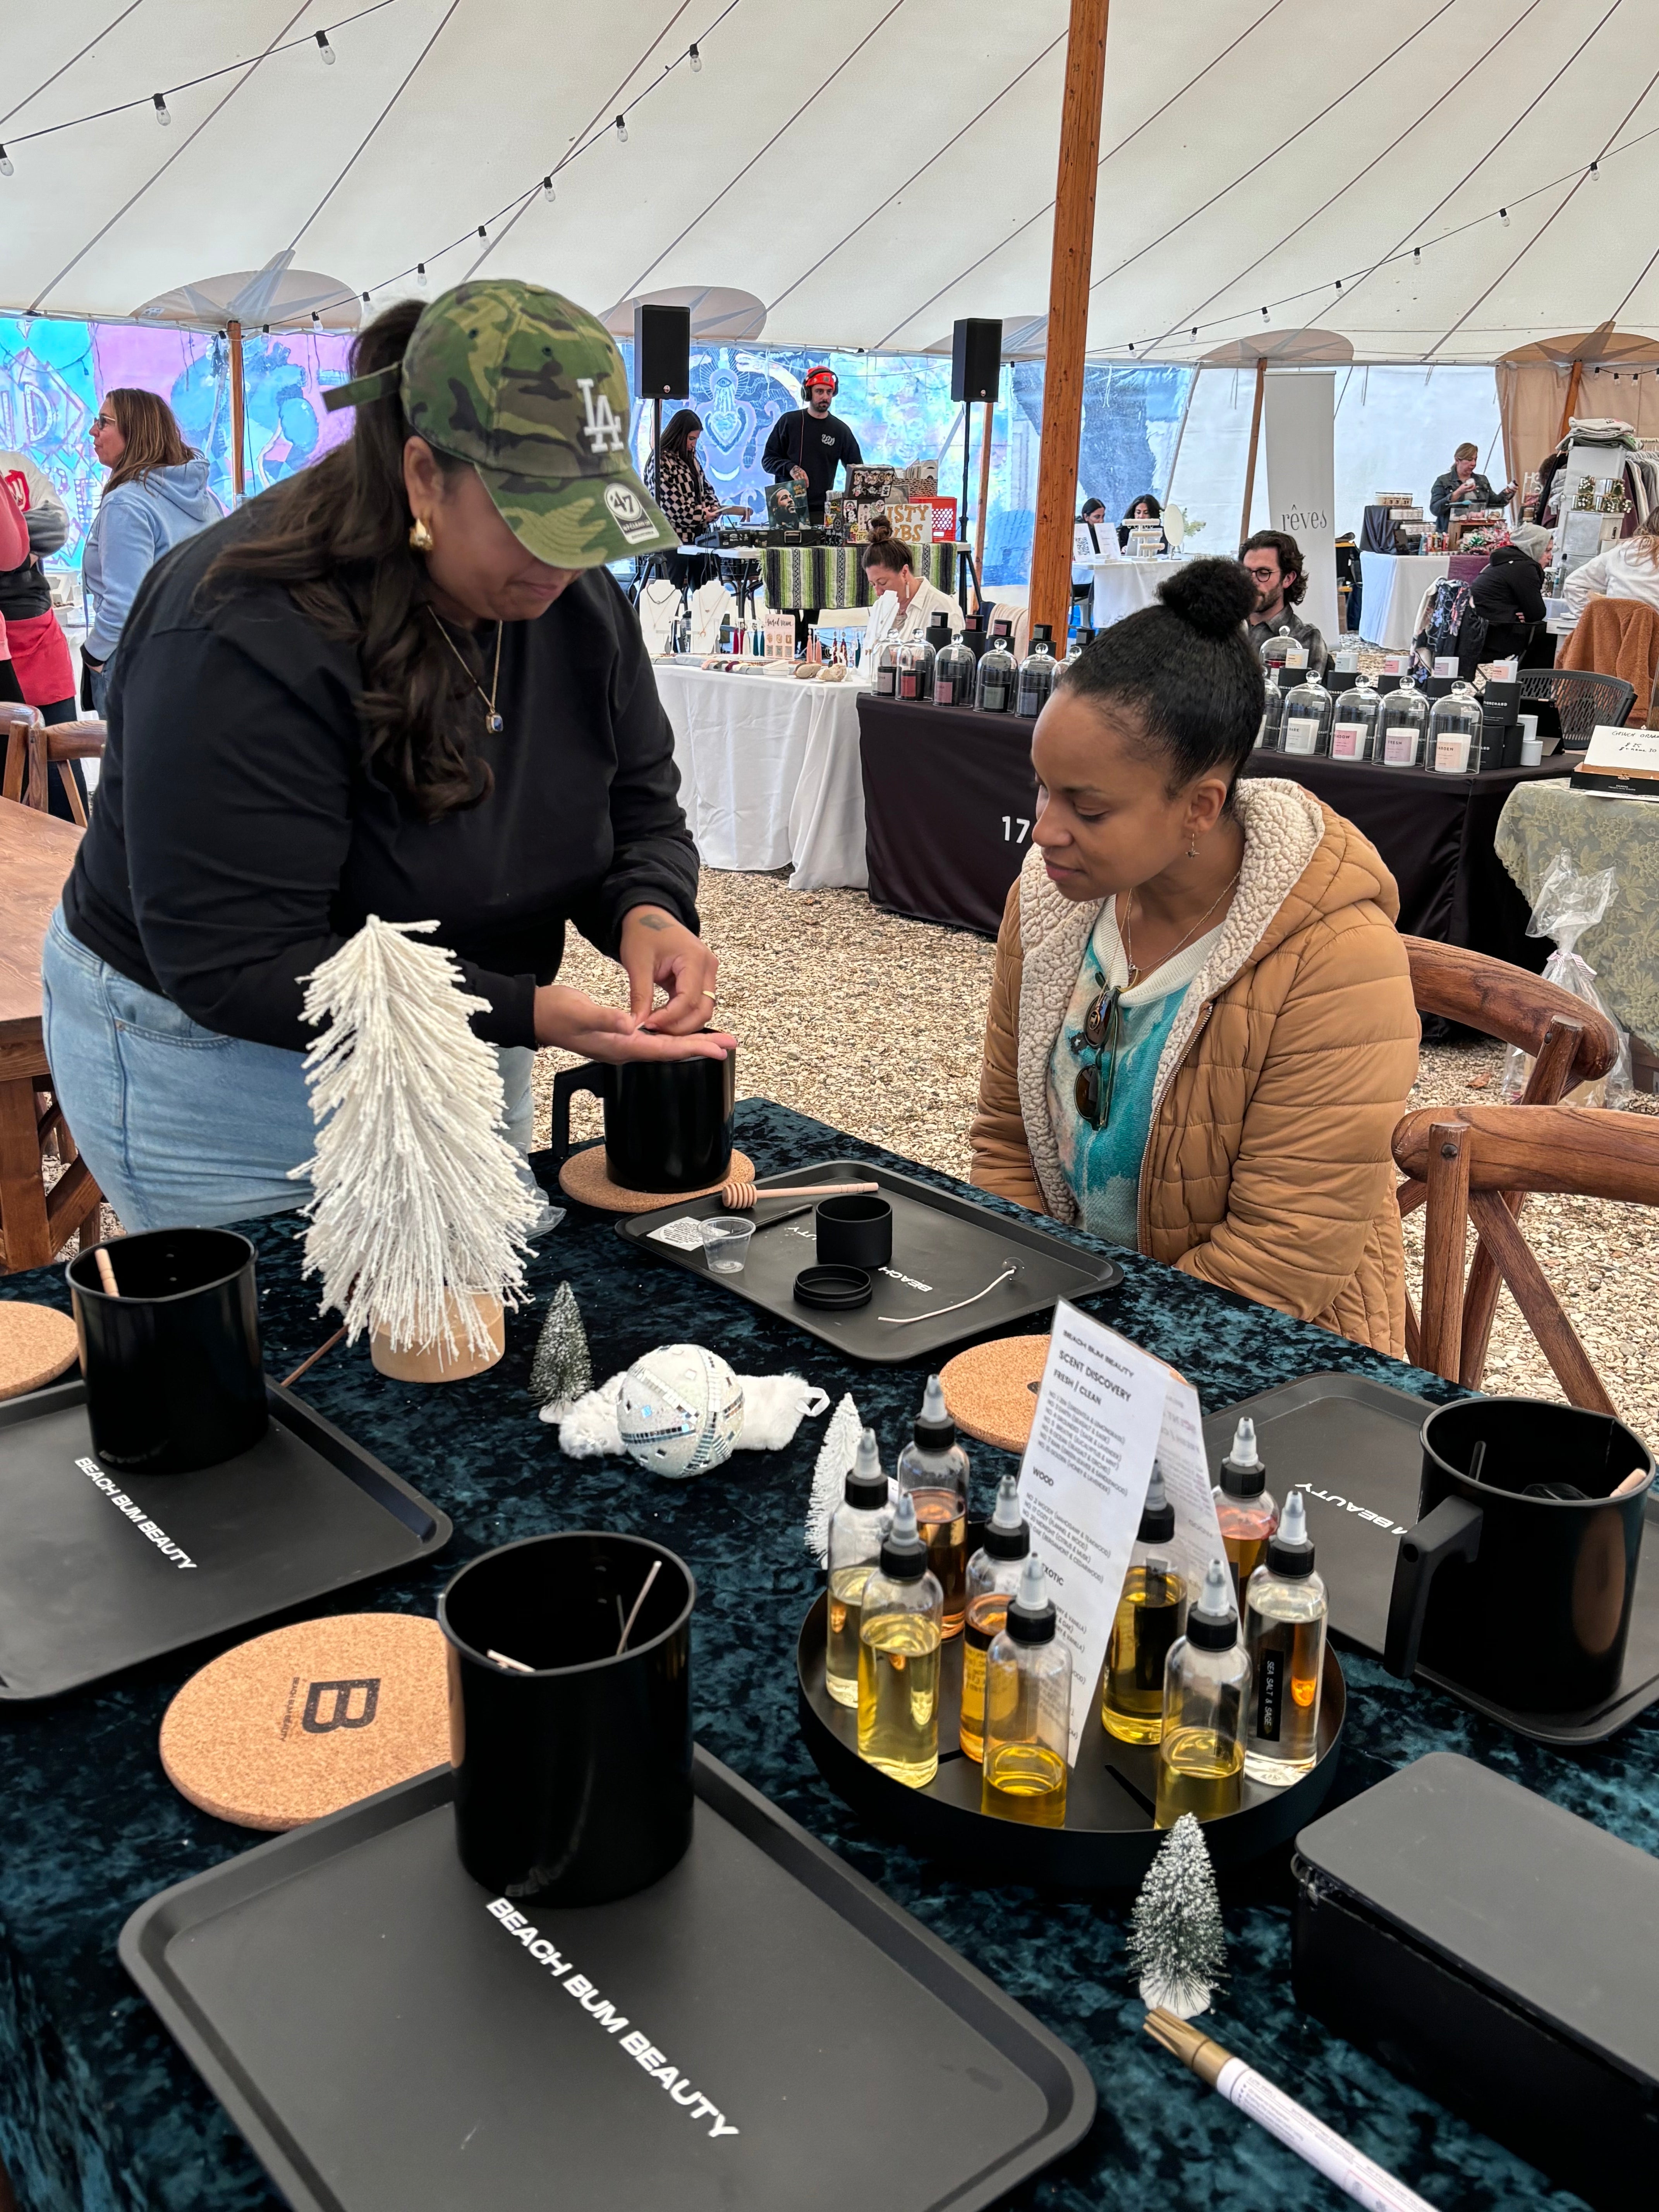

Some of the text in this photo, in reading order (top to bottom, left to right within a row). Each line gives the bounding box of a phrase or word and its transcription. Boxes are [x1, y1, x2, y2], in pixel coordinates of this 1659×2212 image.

[577, 378, 624, 453] LA
[1281, 504, 1327, 531] rêves
[1002, 816, 1030, 843] 17
[878, 1266, 933, 1292] BEACH
[1059, 1350, 1084, 1373] SCENT
[1085, 1366, 1131, 1403] DISCOVERY
[1104, 1355, 1133, 1378] BEAUTY
[1054, 1369, 1074, 1388] FRESH
[1079, 1385, 1101, 1406] CLEAN
[1033, 1466, 1054, 1488] WOOD
[74, 1457, 198, 1569] BEACH BUM BEAUTY
[1295, 1482, 1395, 1528] BEAUTY
[1069, 1614, 1086, 1635] VANILLA)
[1066, 1632, 1084, 1654] VANILLA)
[302, 1678, 381, 1733] B
[486, 1898, 739, 2137] BEACH BUM BEAUTY
